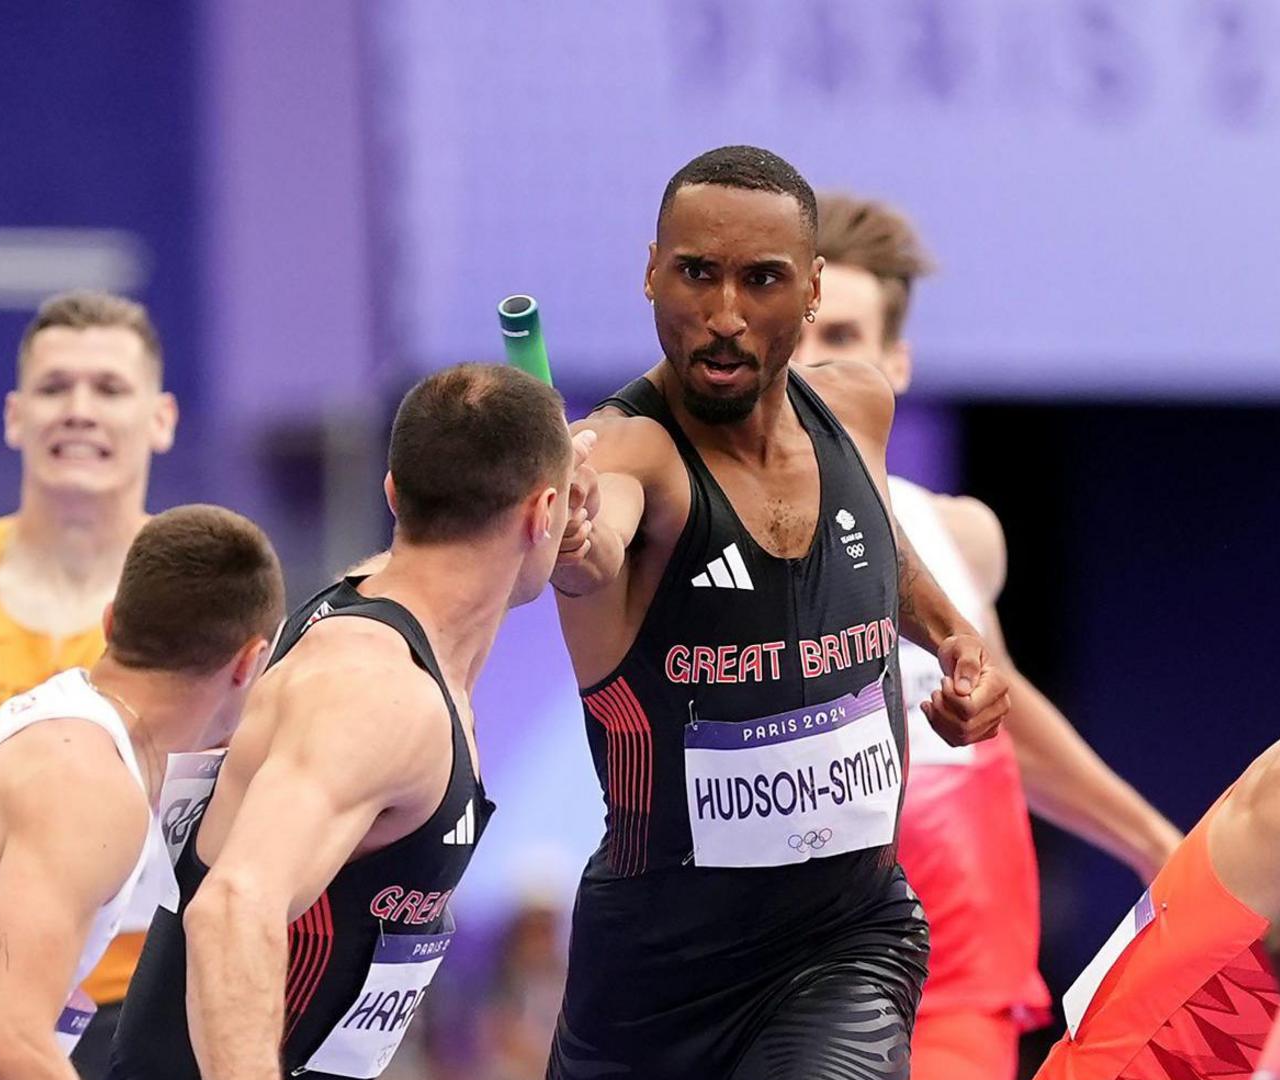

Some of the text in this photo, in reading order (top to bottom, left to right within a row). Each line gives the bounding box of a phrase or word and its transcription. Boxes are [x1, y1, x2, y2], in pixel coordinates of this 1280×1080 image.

[665, 641, 785, 684] GREAT
[743, 706, 846, 742] PARIS 2024
[695, 739, 899, 821] HUDSON-SMITH
[412, 942, 443, 956] PARIS
